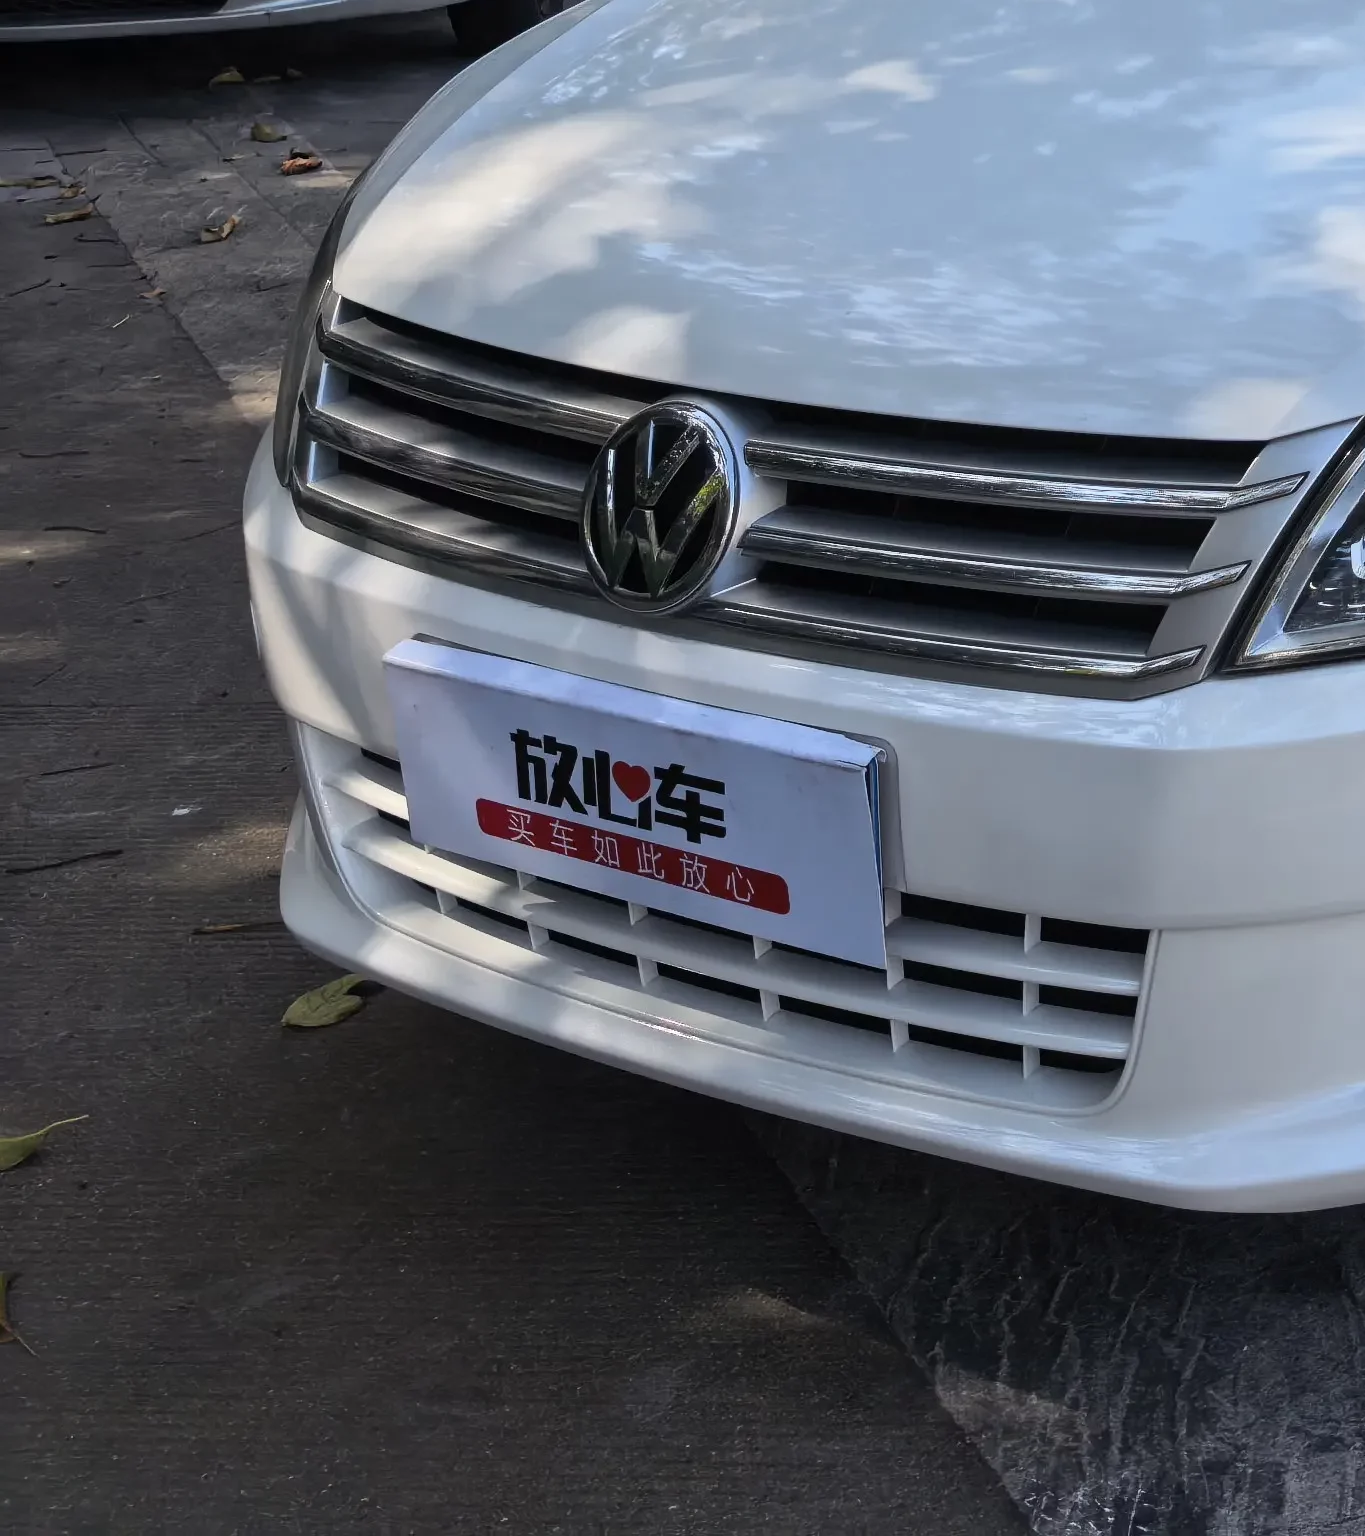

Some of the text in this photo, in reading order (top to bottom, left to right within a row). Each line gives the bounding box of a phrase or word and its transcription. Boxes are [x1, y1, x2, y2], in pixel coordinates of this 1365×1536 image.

[509, 728, 727, 844] 放心车
[506, 808, 755, 903] 买车如此放心
